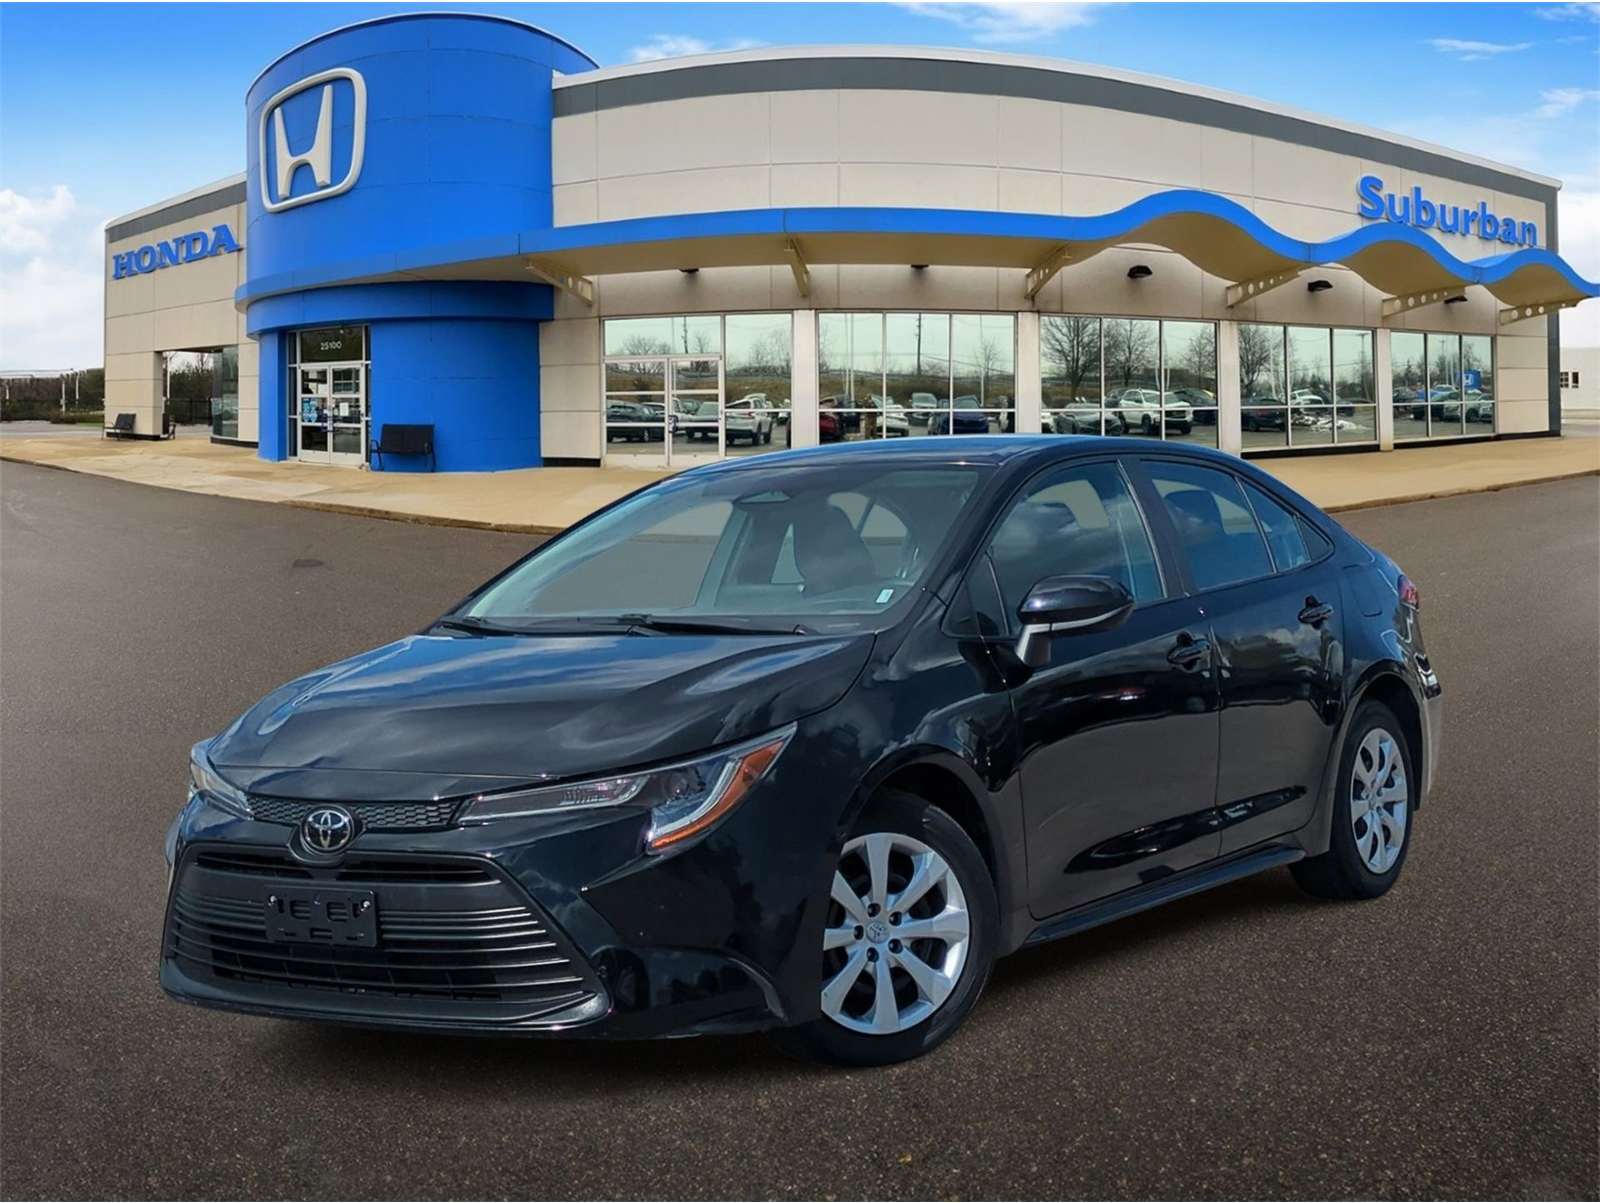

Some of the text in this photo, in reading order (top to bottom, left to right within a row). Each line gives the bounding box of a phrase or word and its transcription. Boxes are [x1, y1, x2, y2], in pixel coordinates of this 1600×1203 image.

[1357, 175, 1538, 247] Suburban
[112, 223, 242, 280] HONDA
[320, 340, 343, 351] 25100
